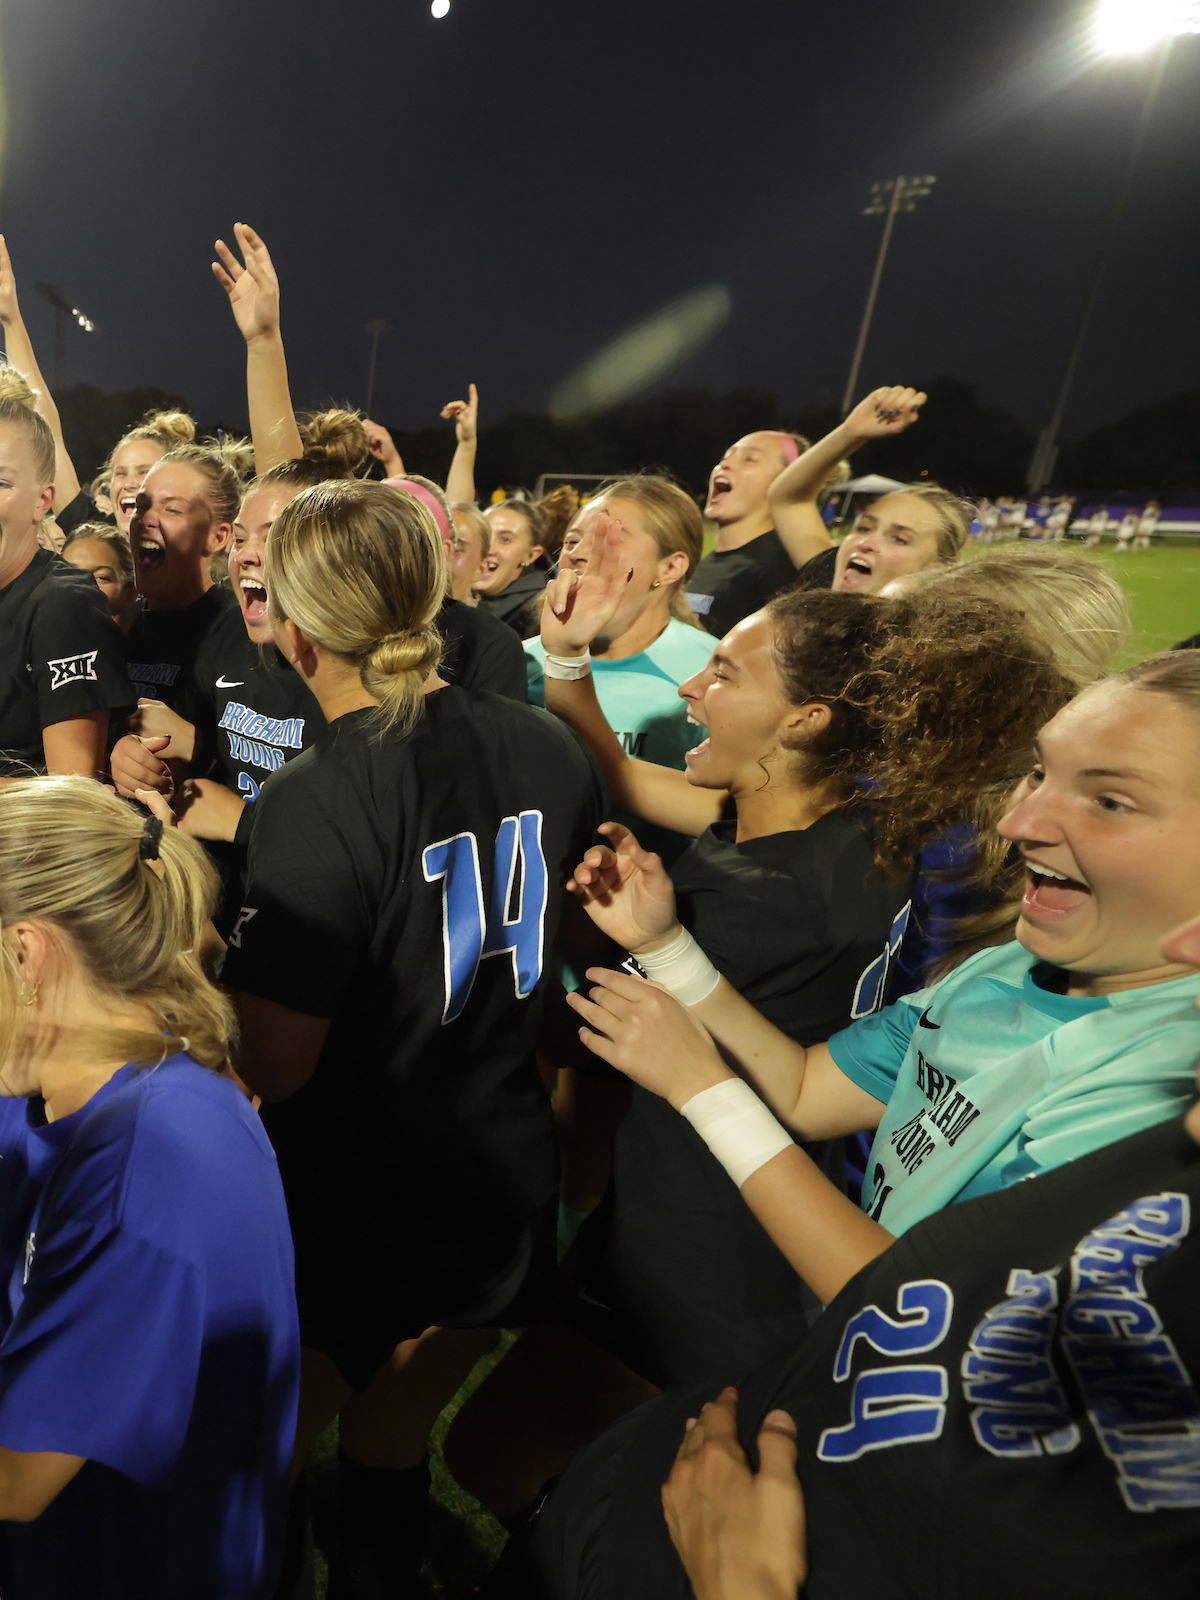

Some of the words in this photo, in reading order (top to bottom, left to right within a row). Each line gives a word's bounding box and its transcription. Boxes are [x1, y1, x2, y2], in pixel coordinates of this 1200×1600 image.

[49, 655, 95, 685] XII
[218, 701, 305, 749] BRIGHAM
[227, 731, 286, 772] YOUNG
[422, 809, 548, 1026] 14
[818, 1279, 953, 1463] 24
